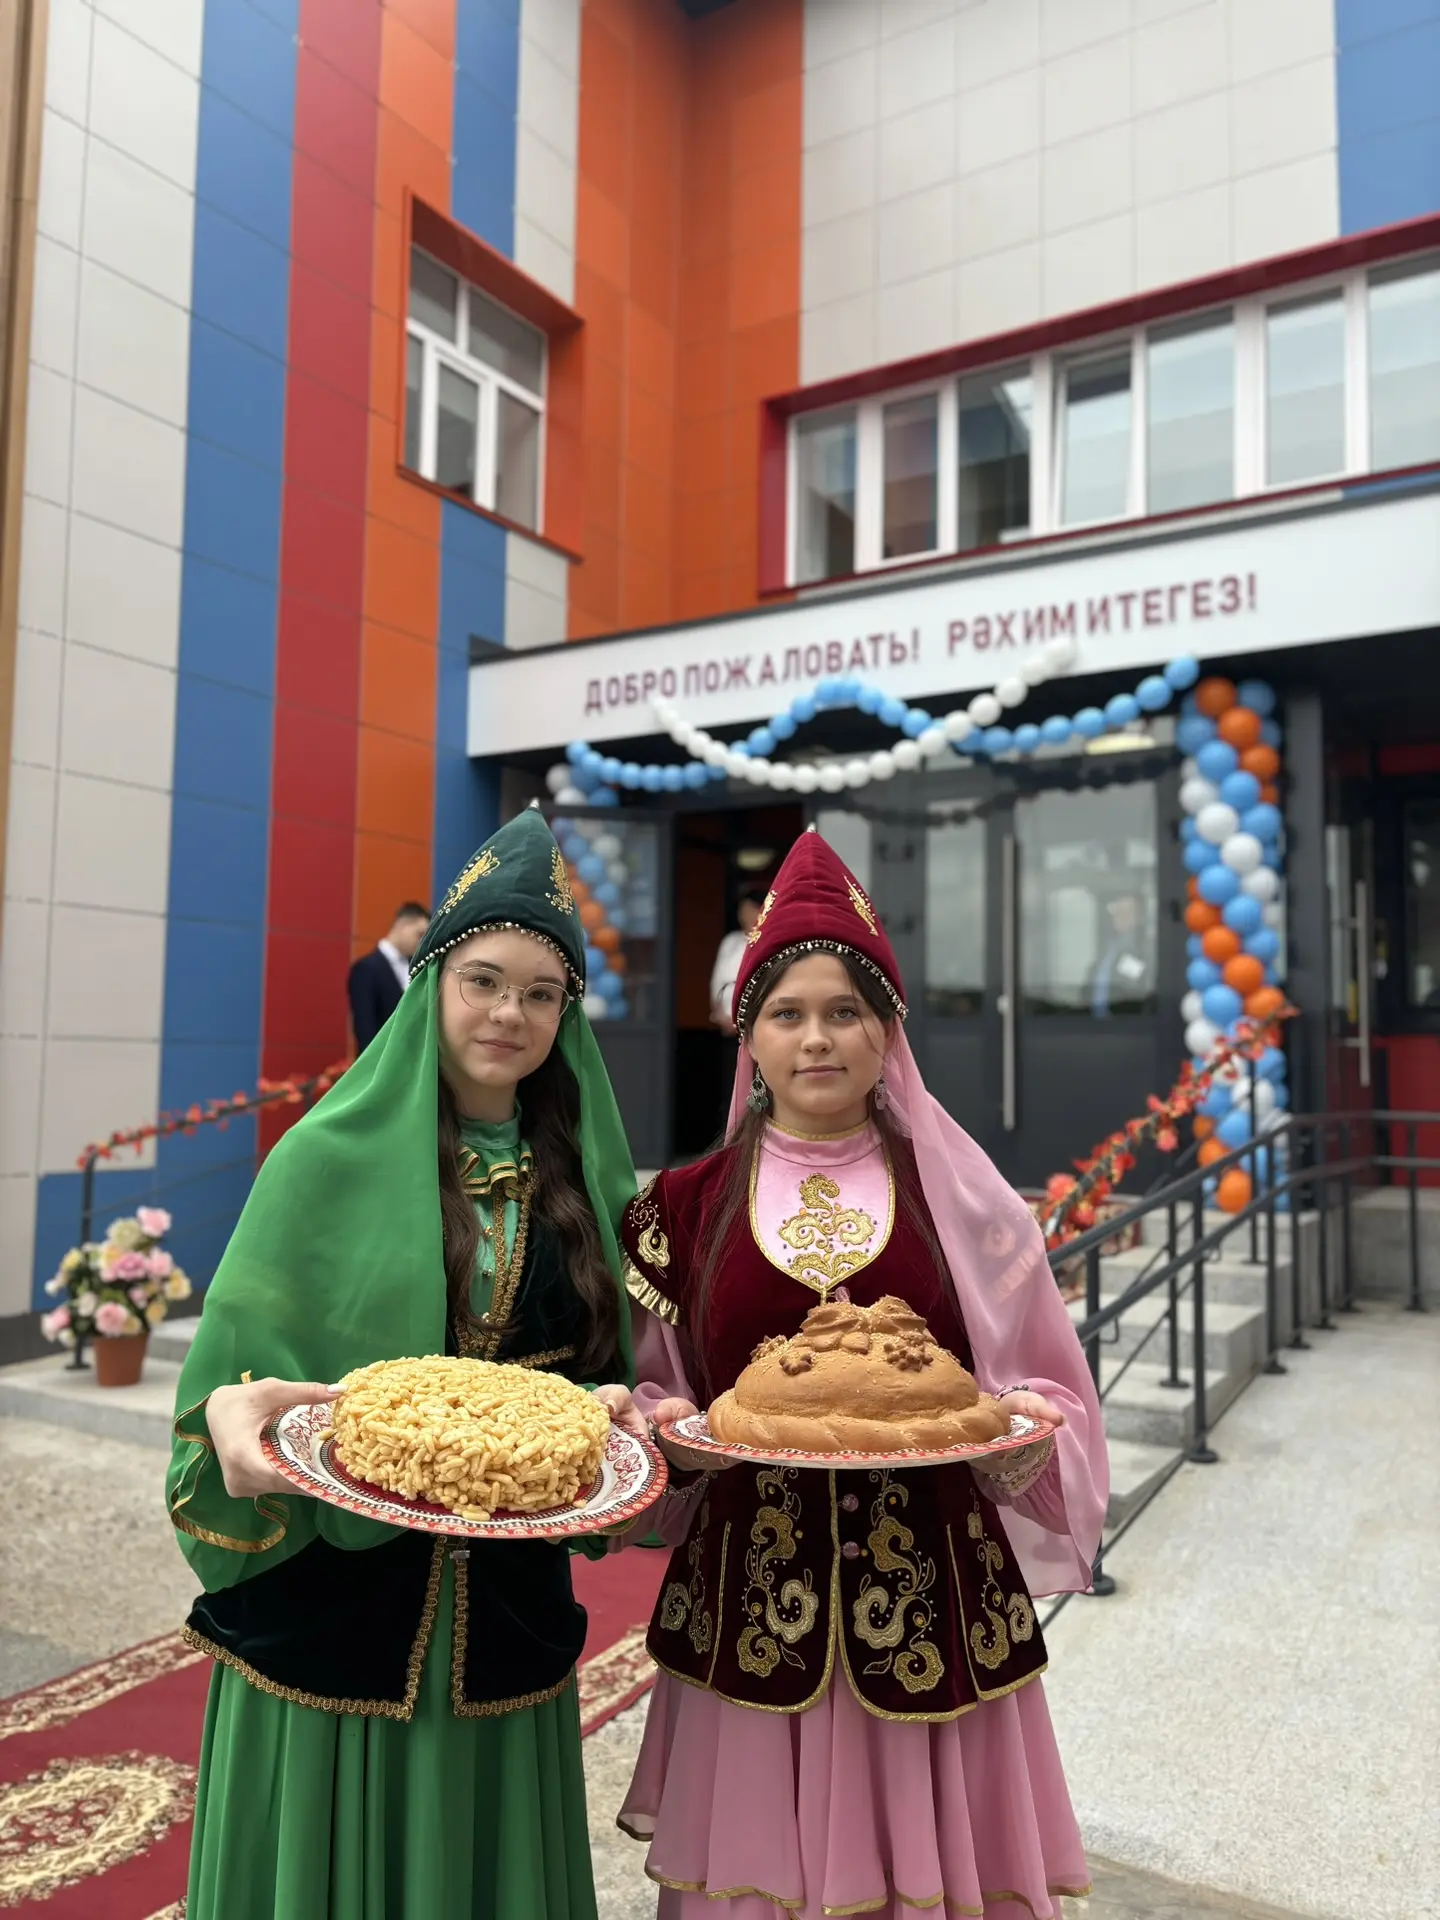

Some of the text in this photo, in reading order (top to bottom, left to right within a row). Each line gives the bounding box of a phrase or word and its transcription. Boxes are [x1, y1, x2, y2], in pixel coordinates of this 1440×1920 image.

[584, 668, 677, 715] ДОБРО
[685, 628, 920, 696] ПОЖАЛОВАТЬ!
[1087, 573, 1257, 634] ИТЕГЕЗ!
